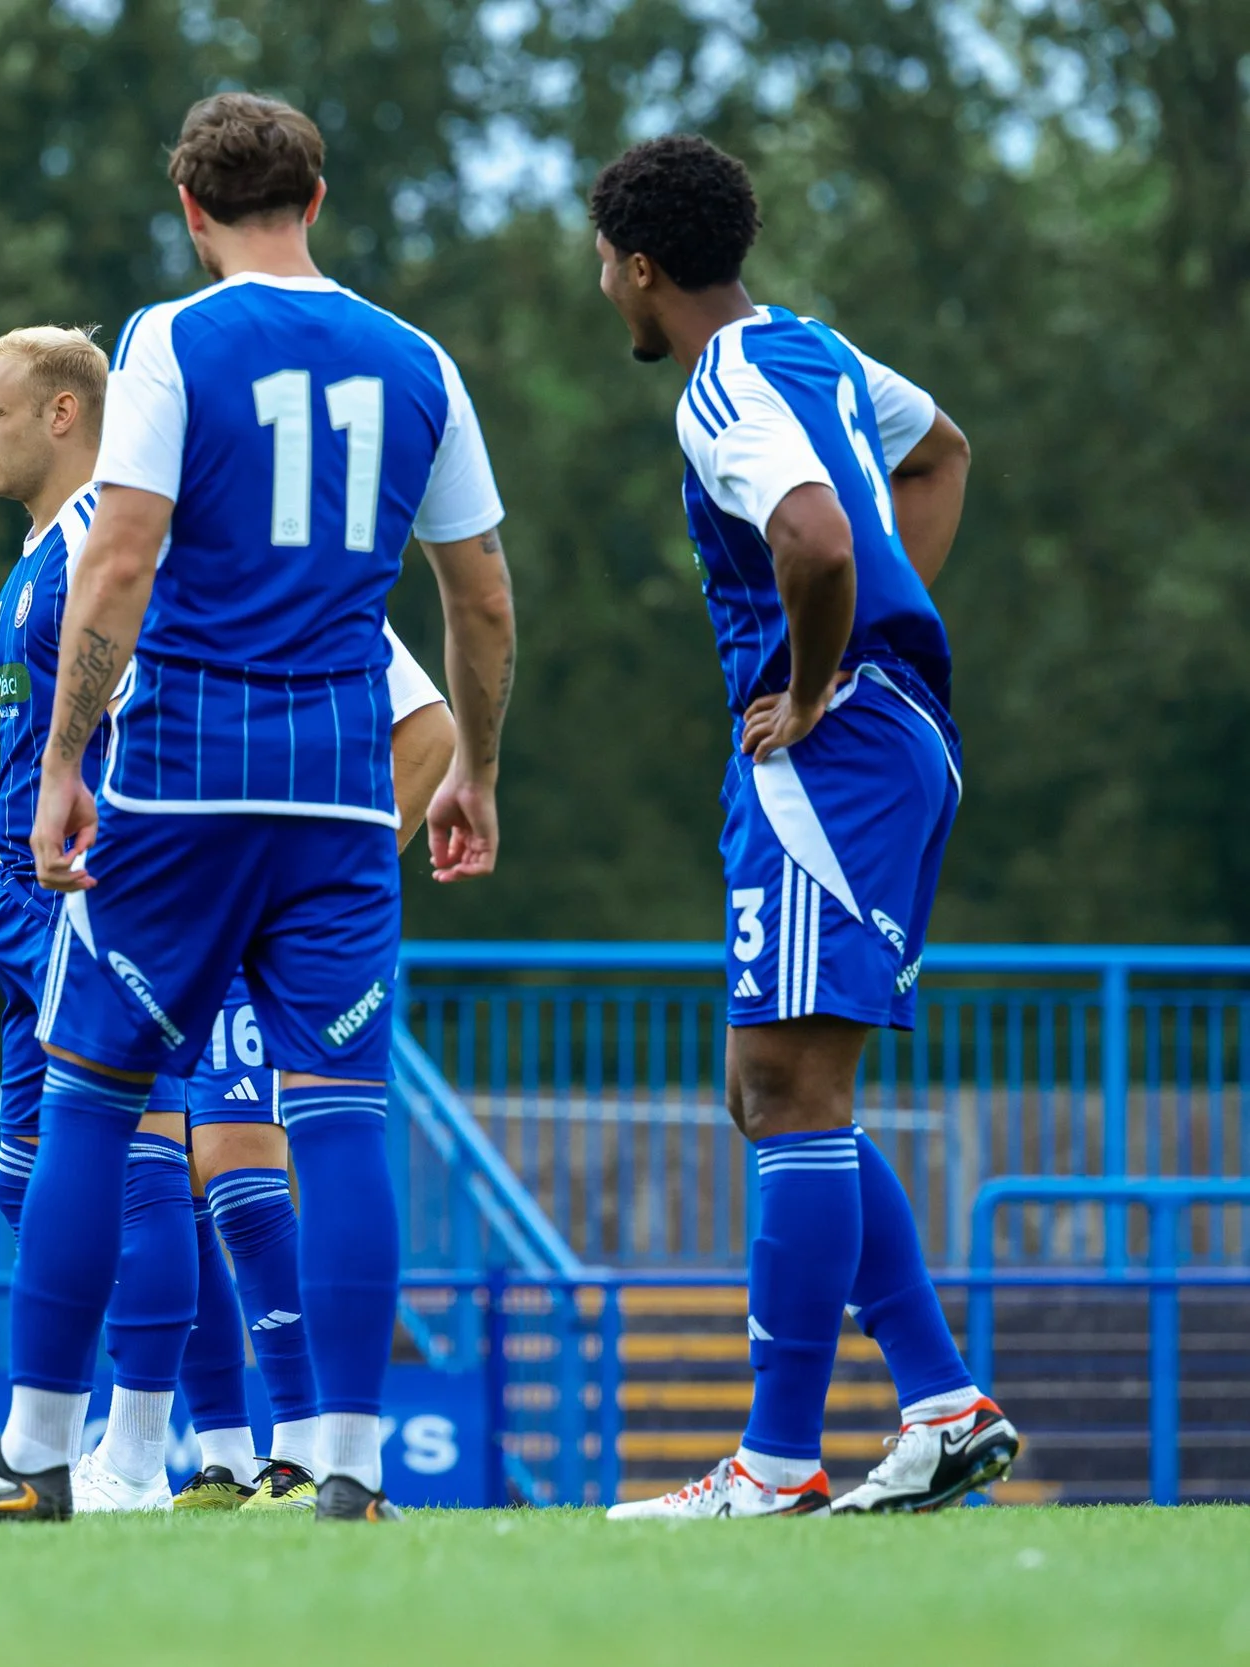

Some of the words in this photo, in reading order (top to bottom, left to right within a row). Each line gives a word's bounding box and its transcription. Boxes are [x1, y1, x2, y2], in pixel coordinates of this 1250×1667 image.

[252, 369, 384, 553] 11
[732, 887, 765, 963] 3
[212, 1004, 264, 1071] 16
[327, 982, 385, 1046] HiSPEC
